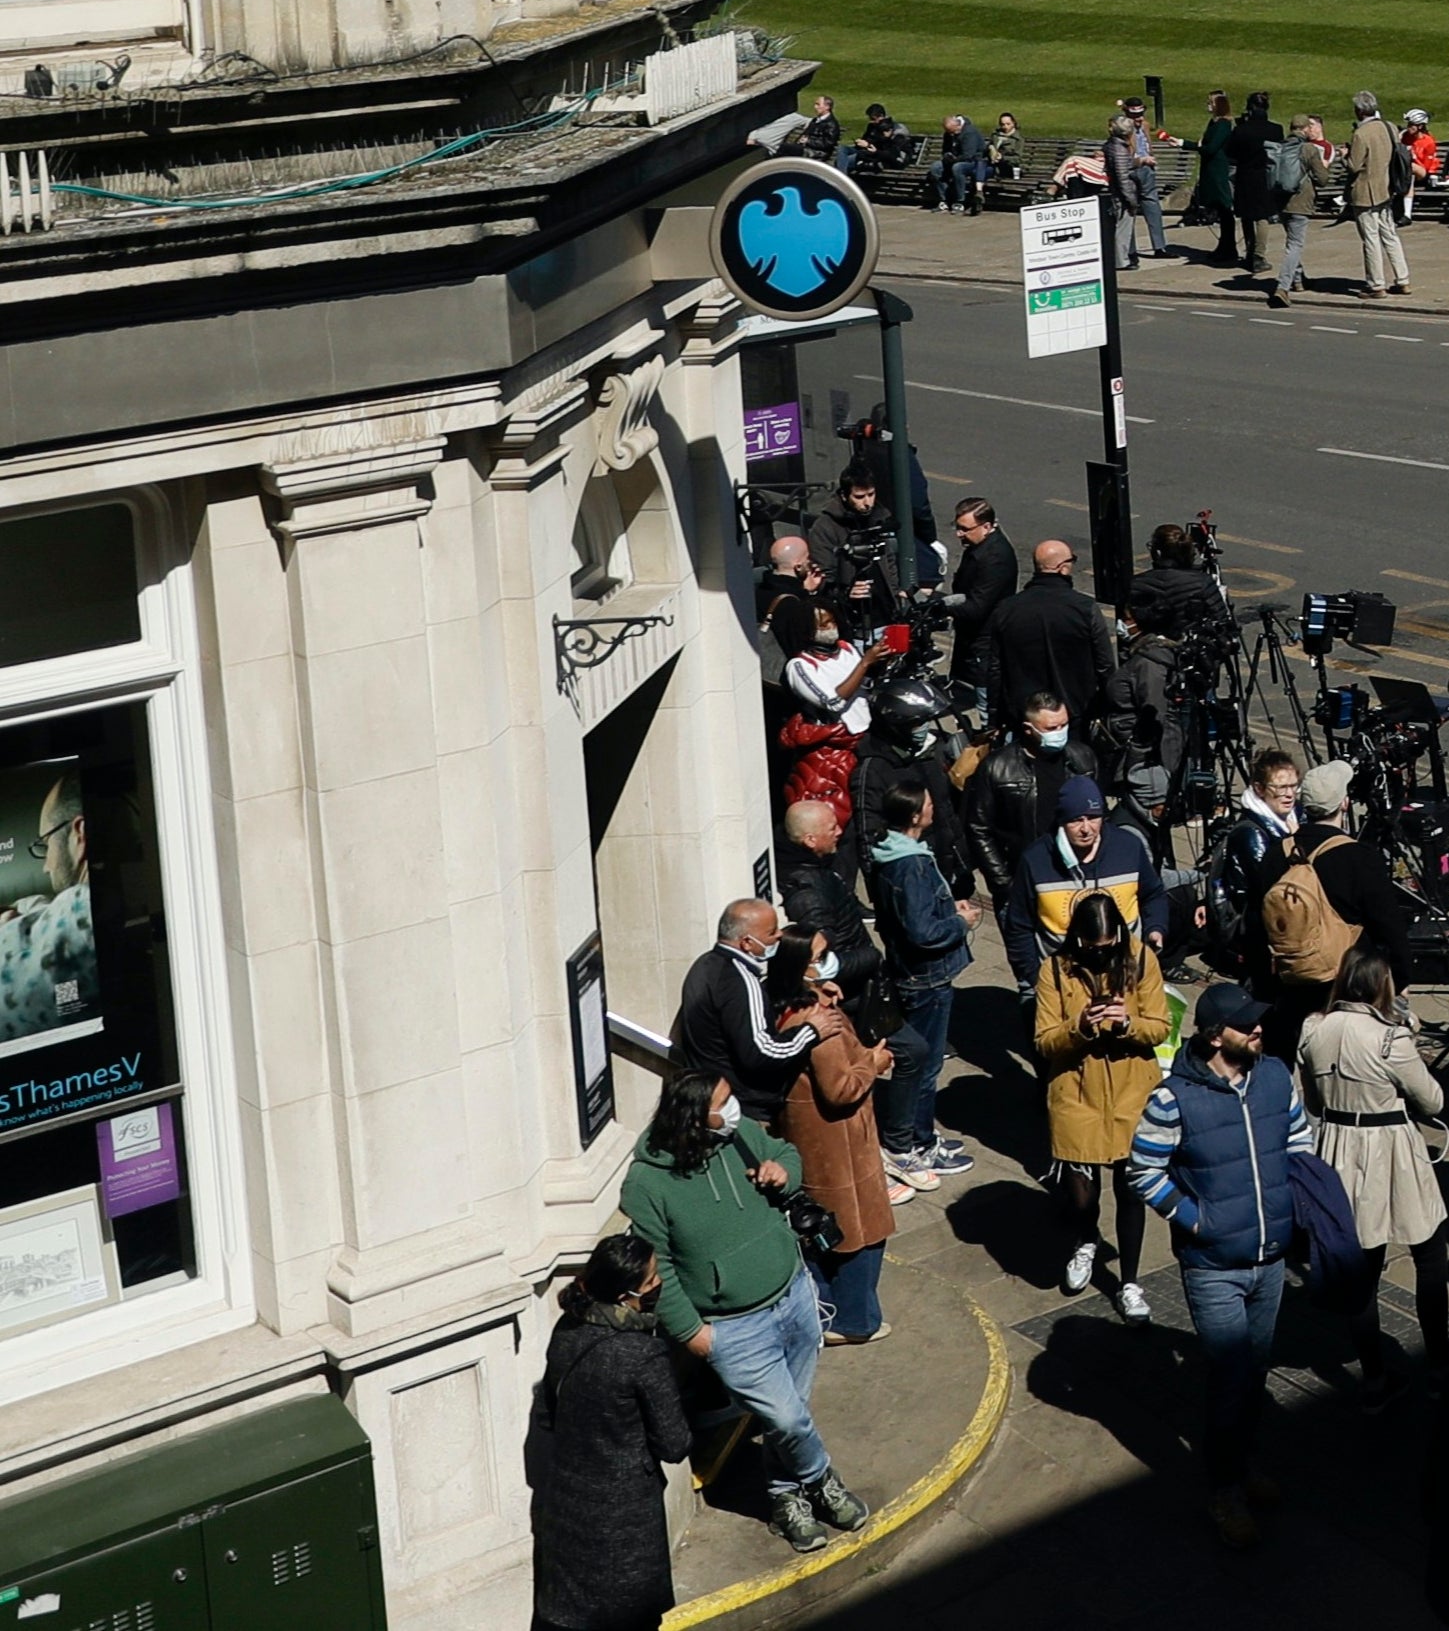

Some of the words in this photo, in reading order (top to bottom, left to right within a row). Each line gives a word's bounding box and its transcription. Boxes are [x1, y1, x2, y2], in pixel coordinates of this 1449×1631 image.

[1036, 211, 1057, 222] Bus
[1061, 207, 1086, 218] Stop
[28, 1103, 60, 1118] what's
[61, 1087, 113, 1110] happening
[113, 1080, 144, 1095] locally
